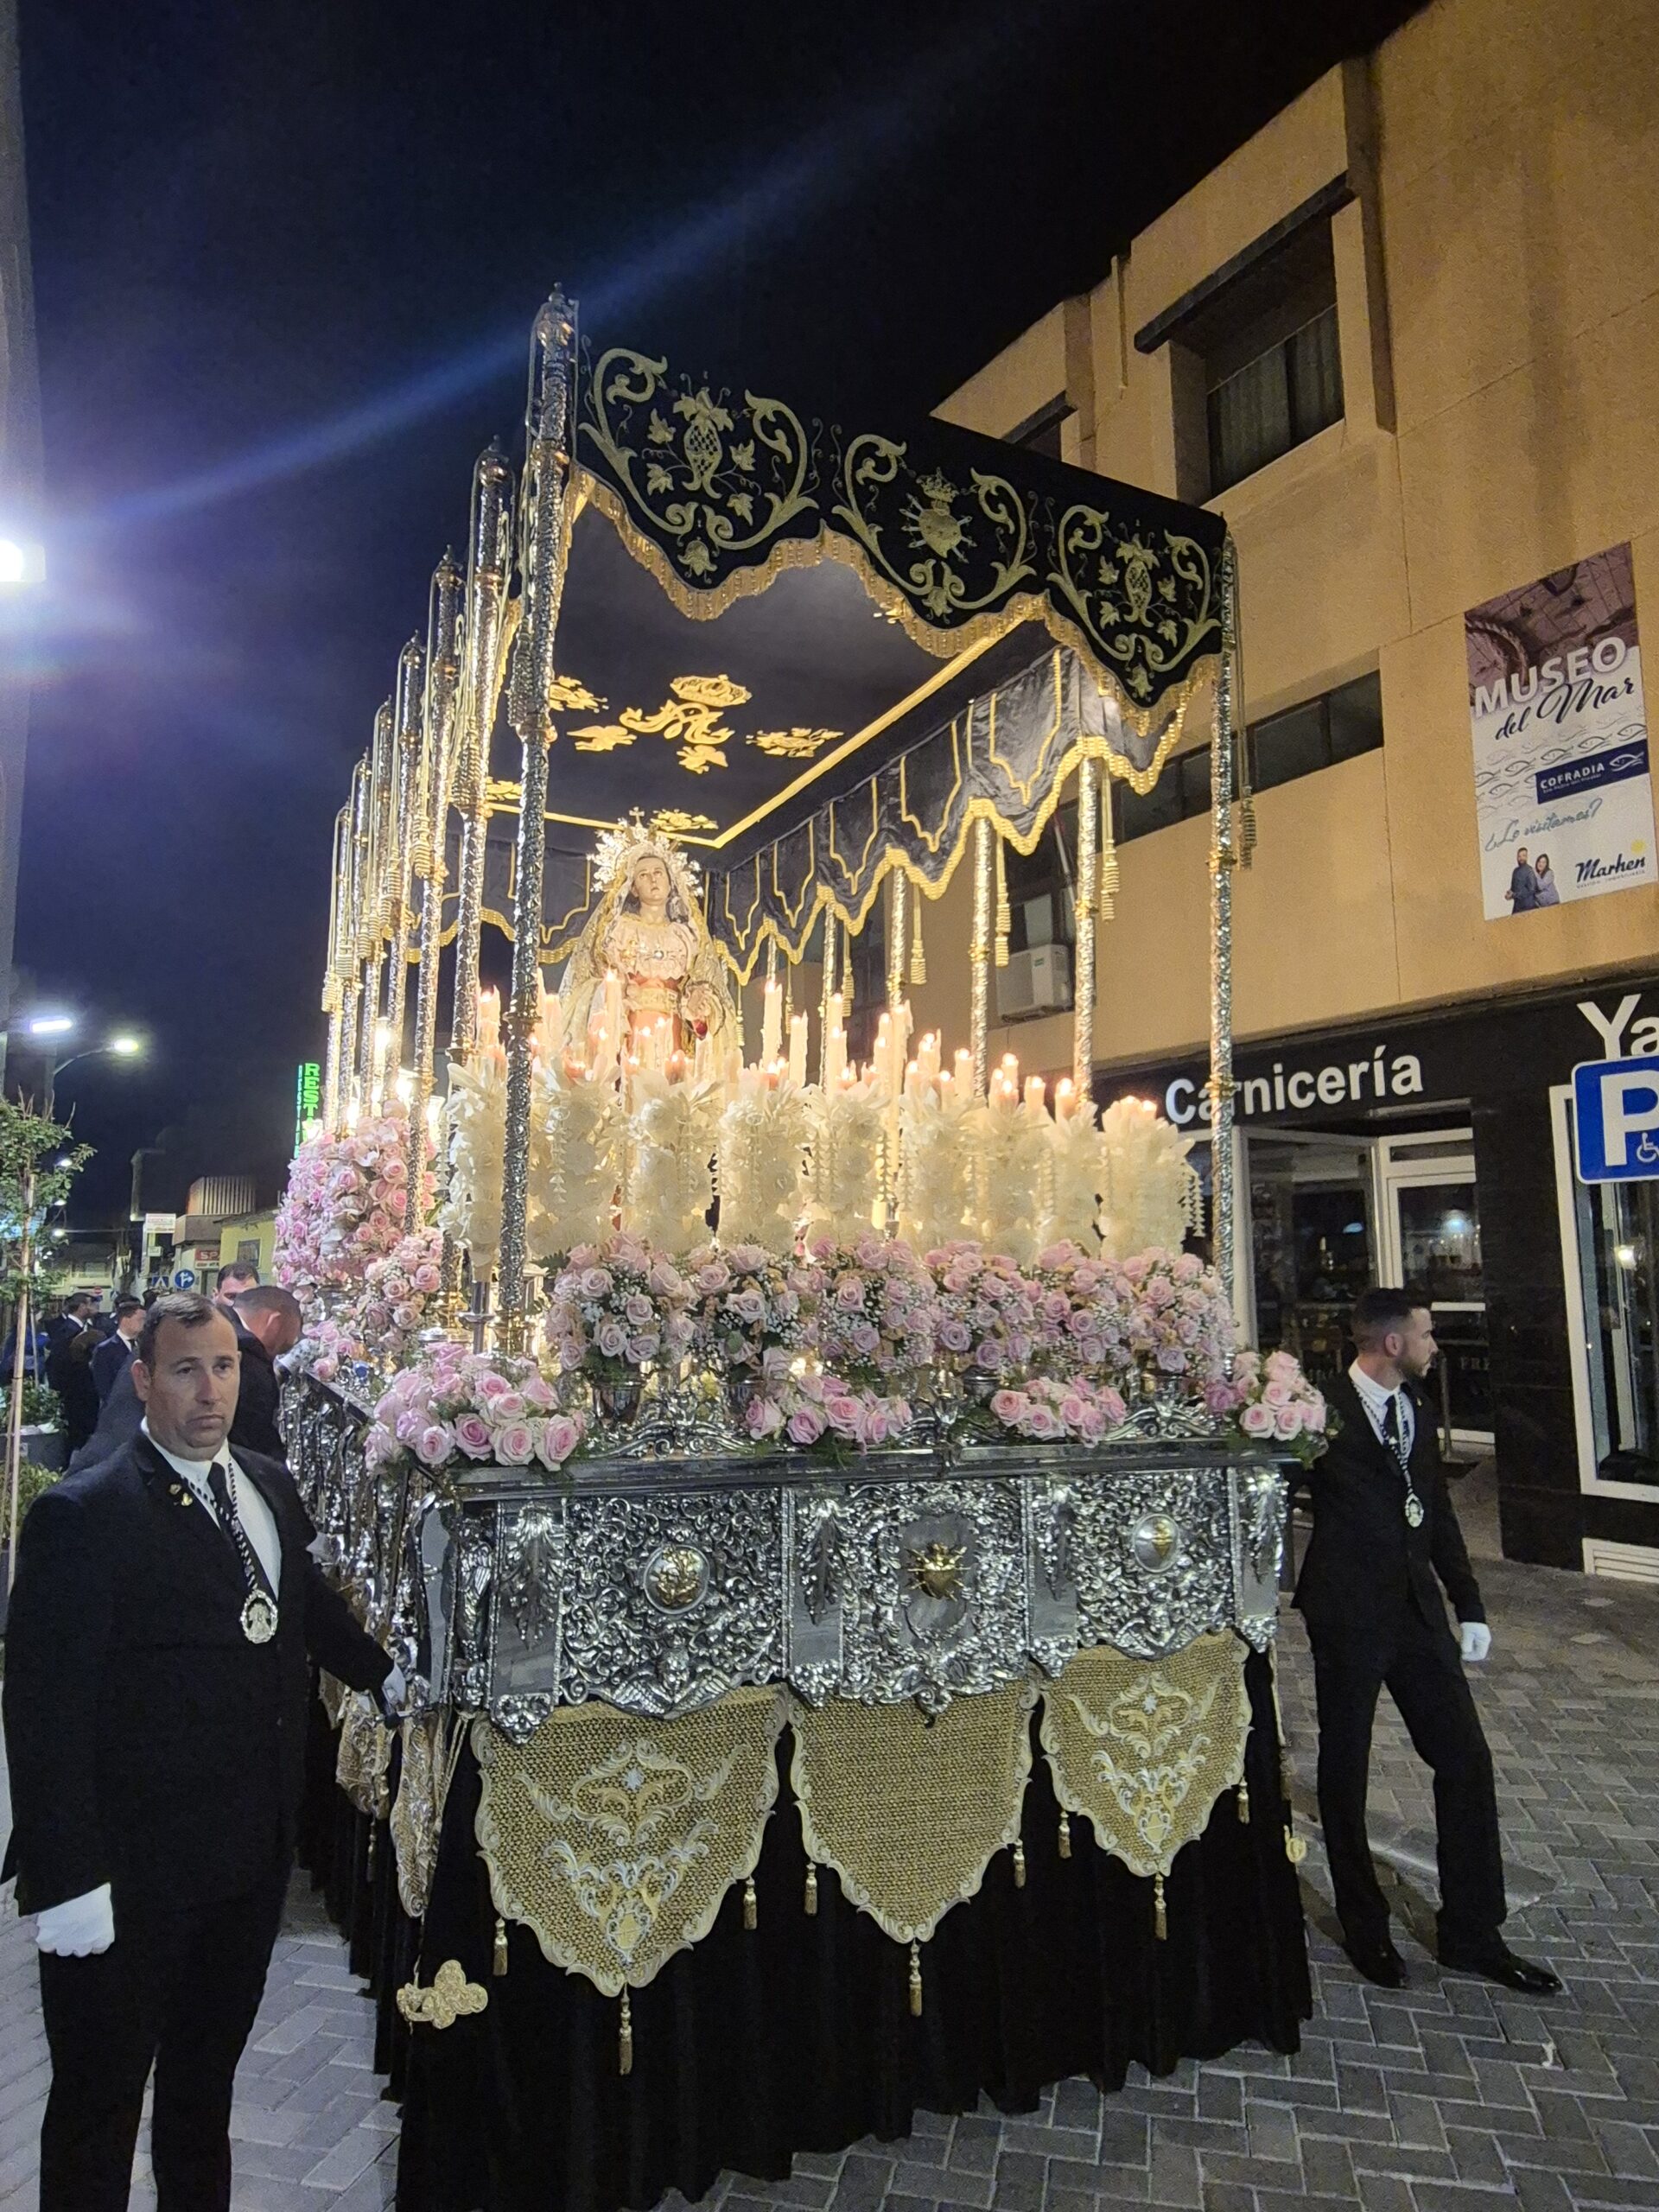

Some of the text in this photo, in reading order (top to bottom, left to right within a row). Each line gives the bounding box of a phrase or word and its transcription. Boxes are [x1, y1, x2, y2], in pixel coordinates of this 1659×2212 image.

[1475, 637, 1626, 718] MUSEO
[1496, 677, 1634, 741] del Mar
[1540, 762, 1605, 790] COFRADIA
[1576, 994, 1659, 1060] Ya
[1600, 1070, 1659, 1166] P
